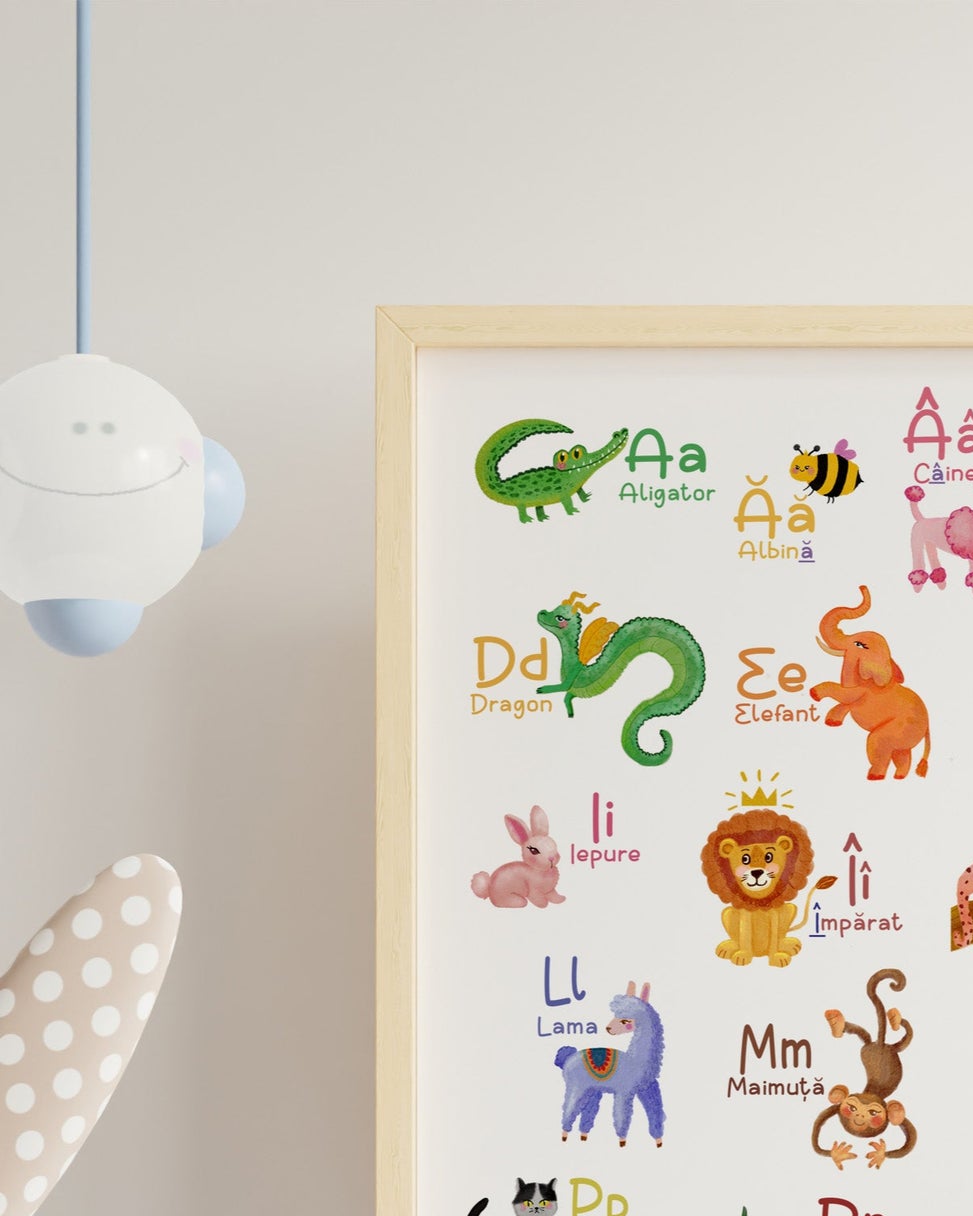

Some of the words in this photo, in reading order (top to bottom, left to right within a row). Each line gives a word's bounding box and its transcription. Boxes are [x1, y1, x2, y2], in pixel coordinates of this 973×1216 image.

[625, 428, 707, 479] Aa
[618, 482, 716, 507] Aligator
[734, 475, 816, 540] Ăă
[738, 540, 815, 562] Albină
[474, 637, 548, 688] Dd
[736, 647, 807, 700] Ee
[471, 694, 552, 719] Dragon
[735, 704, 820, 724] Elefant
[843, 832, 872, 906] Îî
[809, 903, 903, 937] Împărat
[544, 956, 586, 1007] Ll
[537, 1017, 597, 1037] Lama
[740, 1024, 811, 1074] Mm
[727, 1077, 824, 1101] Maimuță
